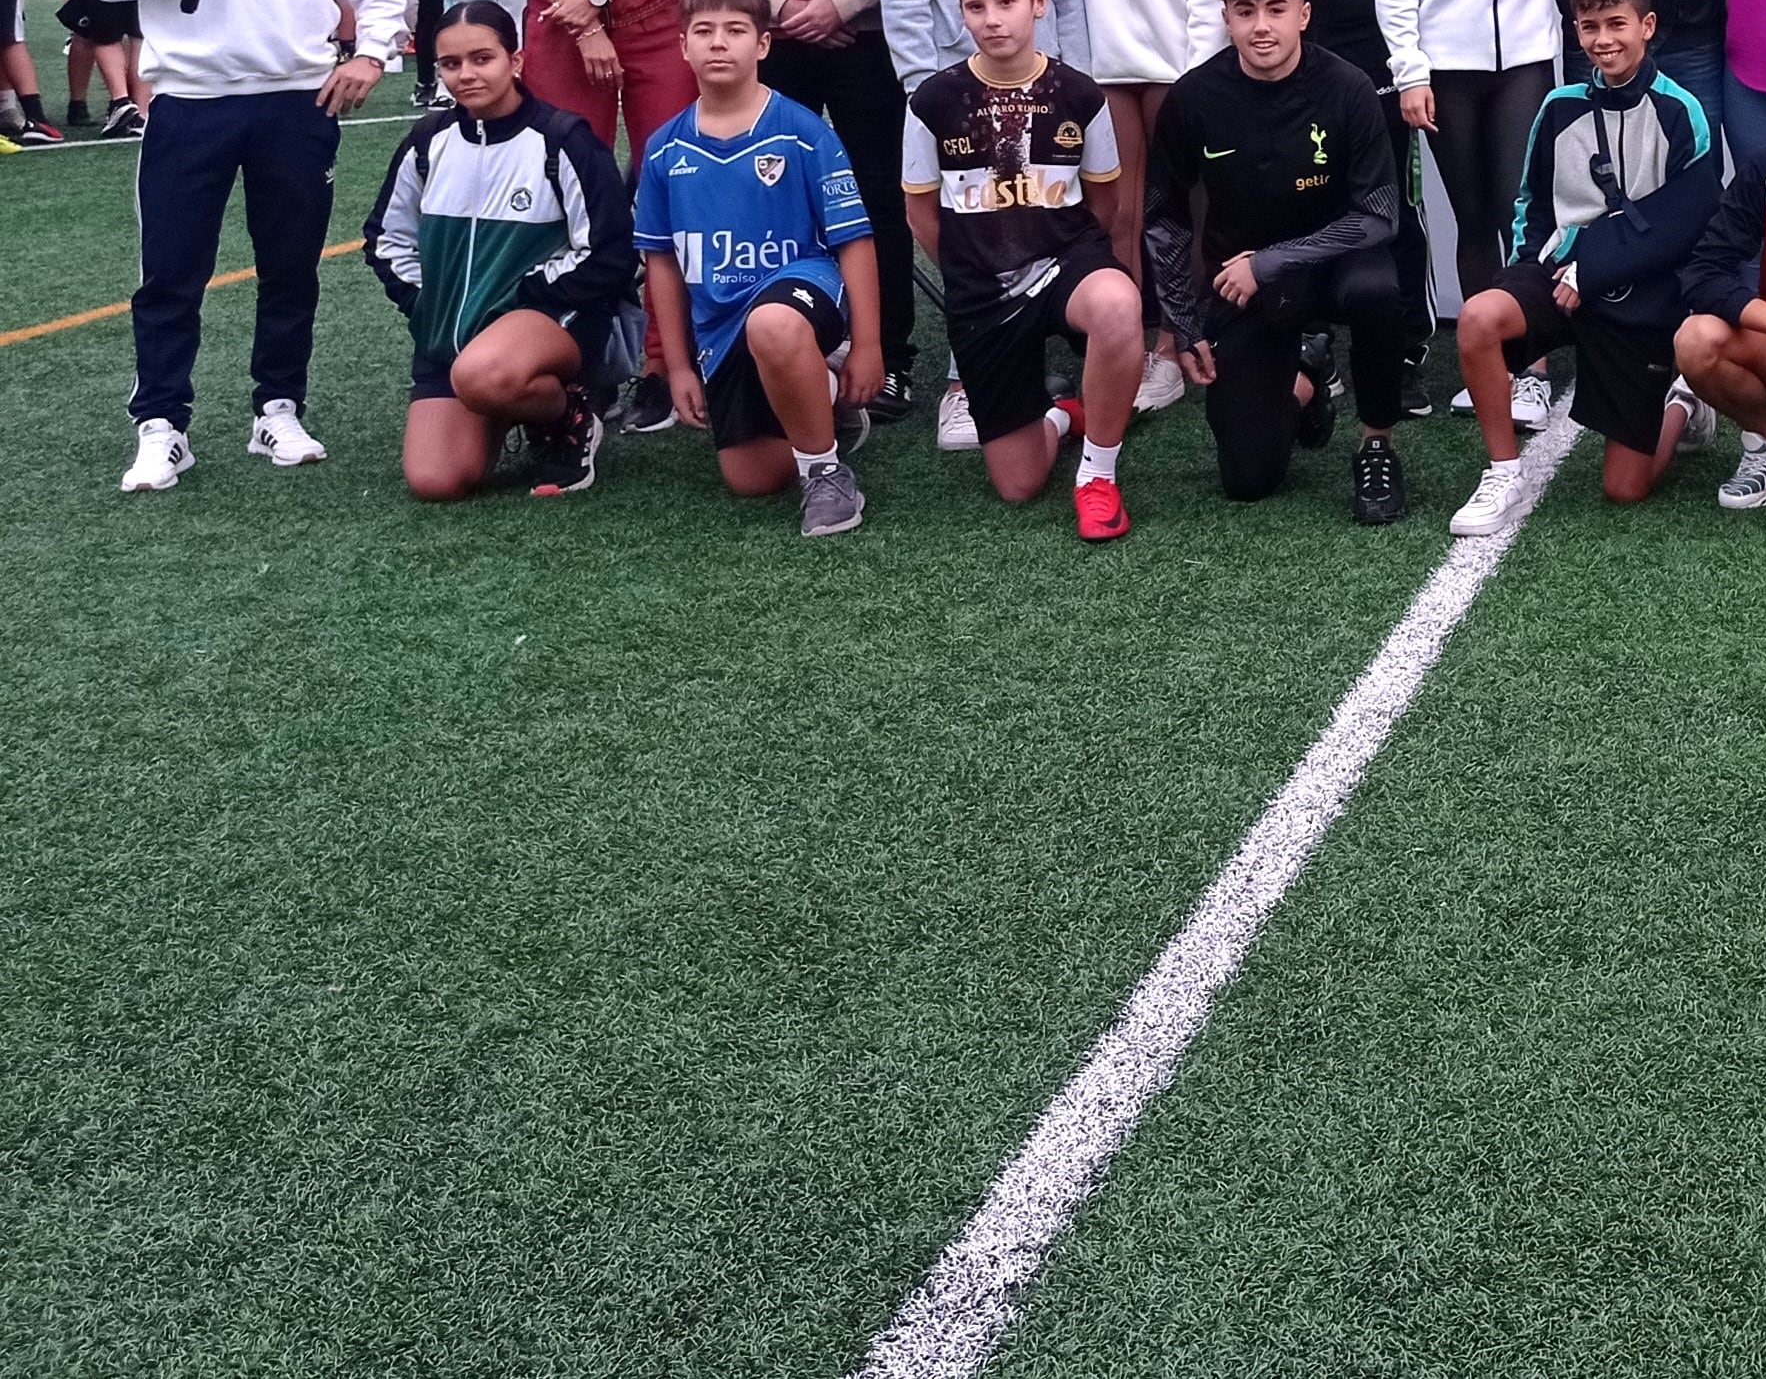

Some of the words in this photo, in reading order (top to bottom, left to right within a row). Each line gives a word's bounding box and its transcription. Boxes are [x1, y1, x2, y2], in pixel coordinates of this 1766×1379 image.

[943, 136, 975, 156] CFCL
[1295, 174, 1330, 191] getir
[712, 230, 799, 271] Jaén
